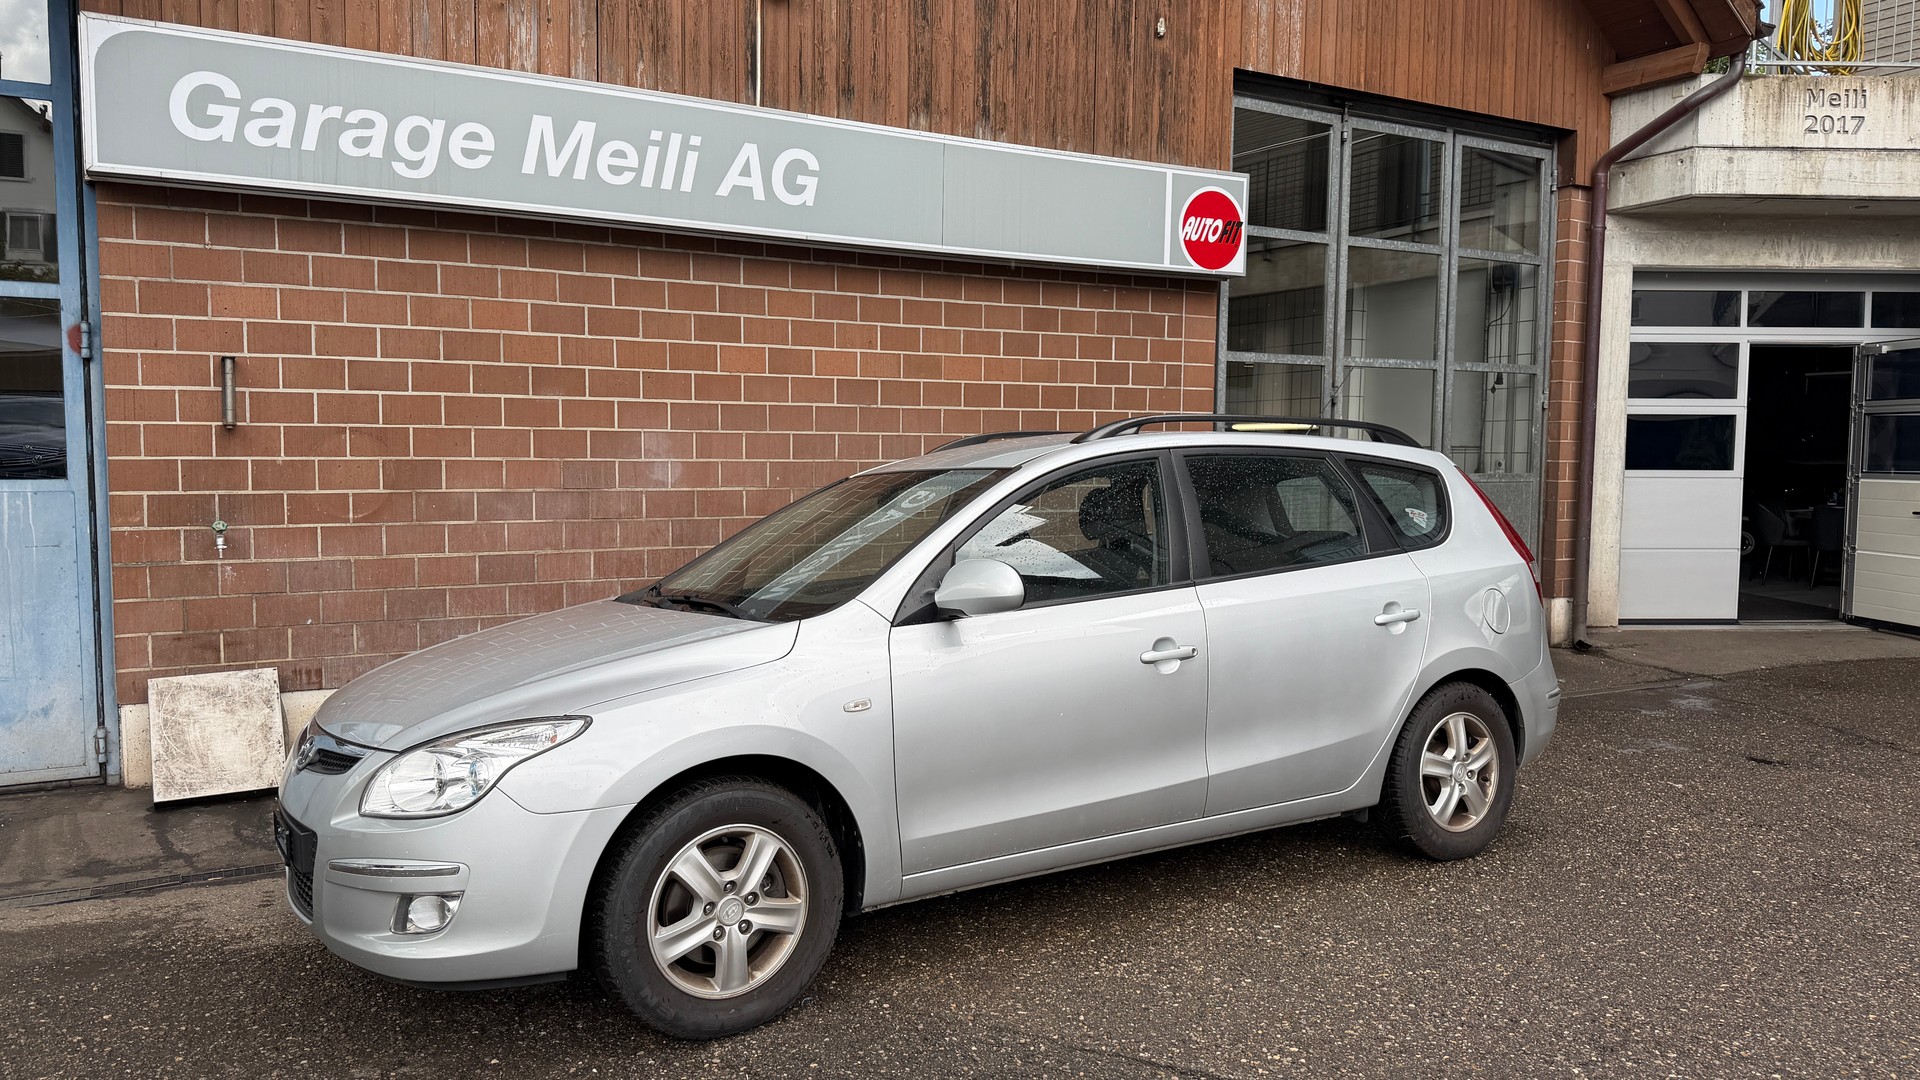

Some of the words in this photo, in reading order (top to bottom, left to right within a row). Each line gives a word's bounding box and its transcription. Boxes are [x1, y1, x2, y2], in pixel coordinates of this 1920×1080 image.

[1806, 88, 1867, 109] Meili
[1804, 115, 1866, 135] 2017
[169, 70, 495, 179] Garage
[521, 114, 702, 193] Meili
[715, 142, 820, 207] AG
[1182, 215, 1244, 245] AUTOFIT
